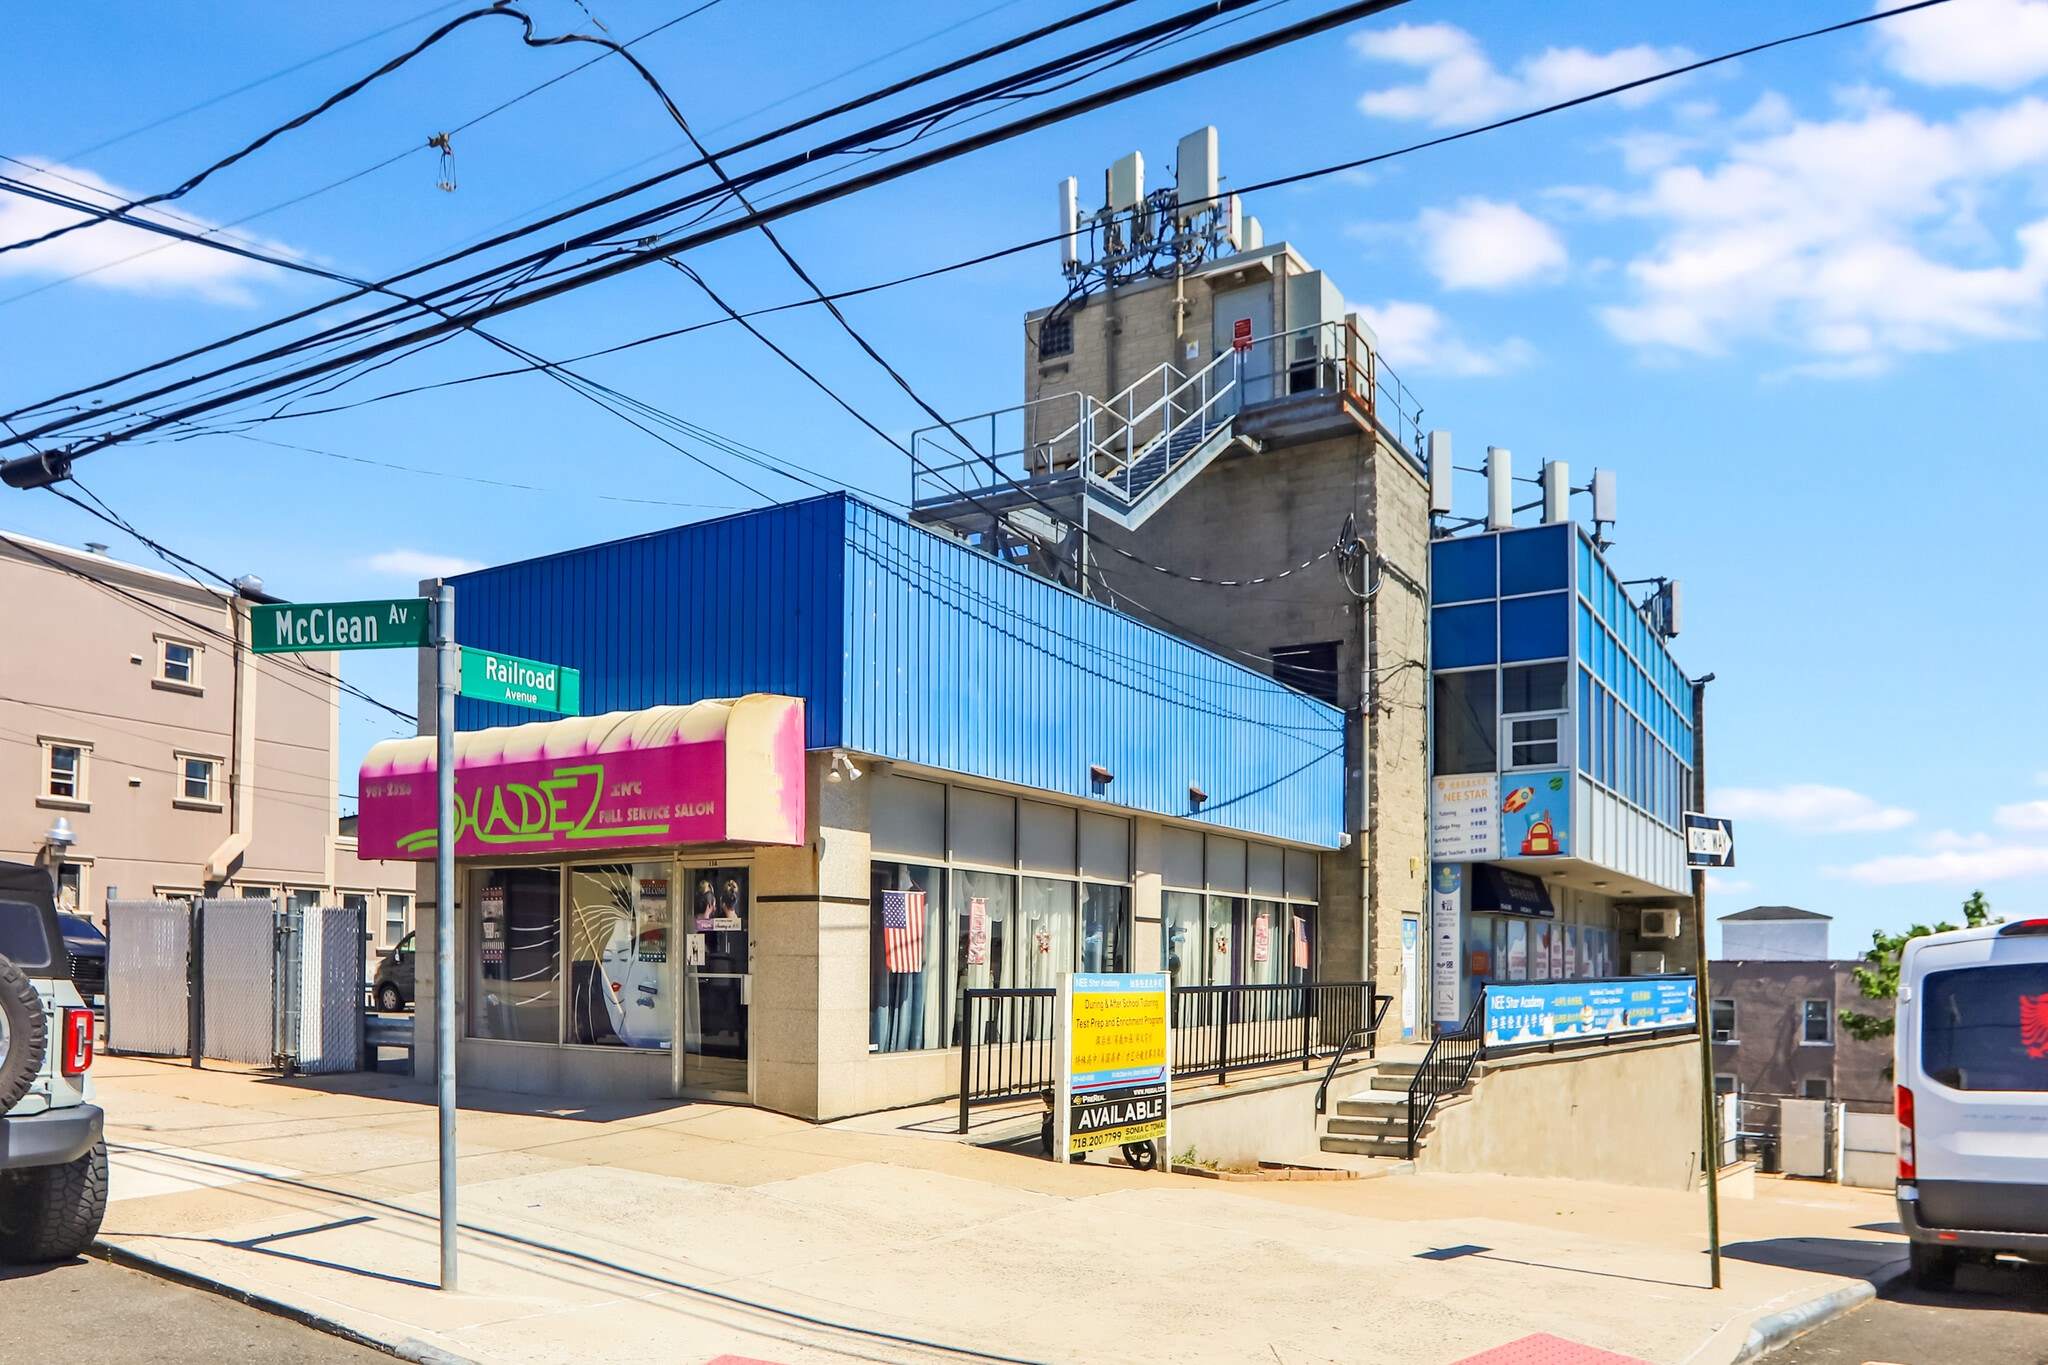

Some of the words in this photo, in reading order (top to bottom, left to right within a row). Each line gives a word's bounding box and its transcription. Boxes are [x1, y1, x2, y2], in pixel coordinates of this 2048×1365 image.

[275, 608, 378, 645] McClean
[388, 603, 409, 625] Av
[485, 656, 556, 692] Railroad
[504, 686, 538, 704] Avenue
[1443, 791, 1461, 802] NEE
[1464, 788, 1488, 800] STAR
[598, 808, 623, 824] FULL
[627, 805, 670, 822] SERVICE
[674, 801, 715, 818] SALON
[640, 887, 666, 895] WELCOME
[1075, 978, 1088, 988] NEE
[1089, 979, 1100, 988] Star
[1085, 999, 1104, 1011] During
[1105, 999, 1109, 1009] &
[1110, 999, 1122, 1009] After
[1123, 998, 1139, 1008] School
[1140, 998, 1159, 1009] Tutoring
[1491, 995, 1505, 1010] NEE
[1505, 996, 1519, 1009] Star
[1520, 994, 1545, 1010] Academy
[1076, 1018, 1090, 1028] Test
[1091, 1018, 1104, 1029] Prep
[1105, 1018, 1116, 1027] and
[1116, 1017, 1144, 1027] Enrichment
[1077, 1098, 1163, 1130] AVAILABLE
[1125, 1126, 1144, 1136] SONIA
[1144, 1124, 1149, 1132] C
[1072, 1131, 1122, 1149] 718.200.7799
